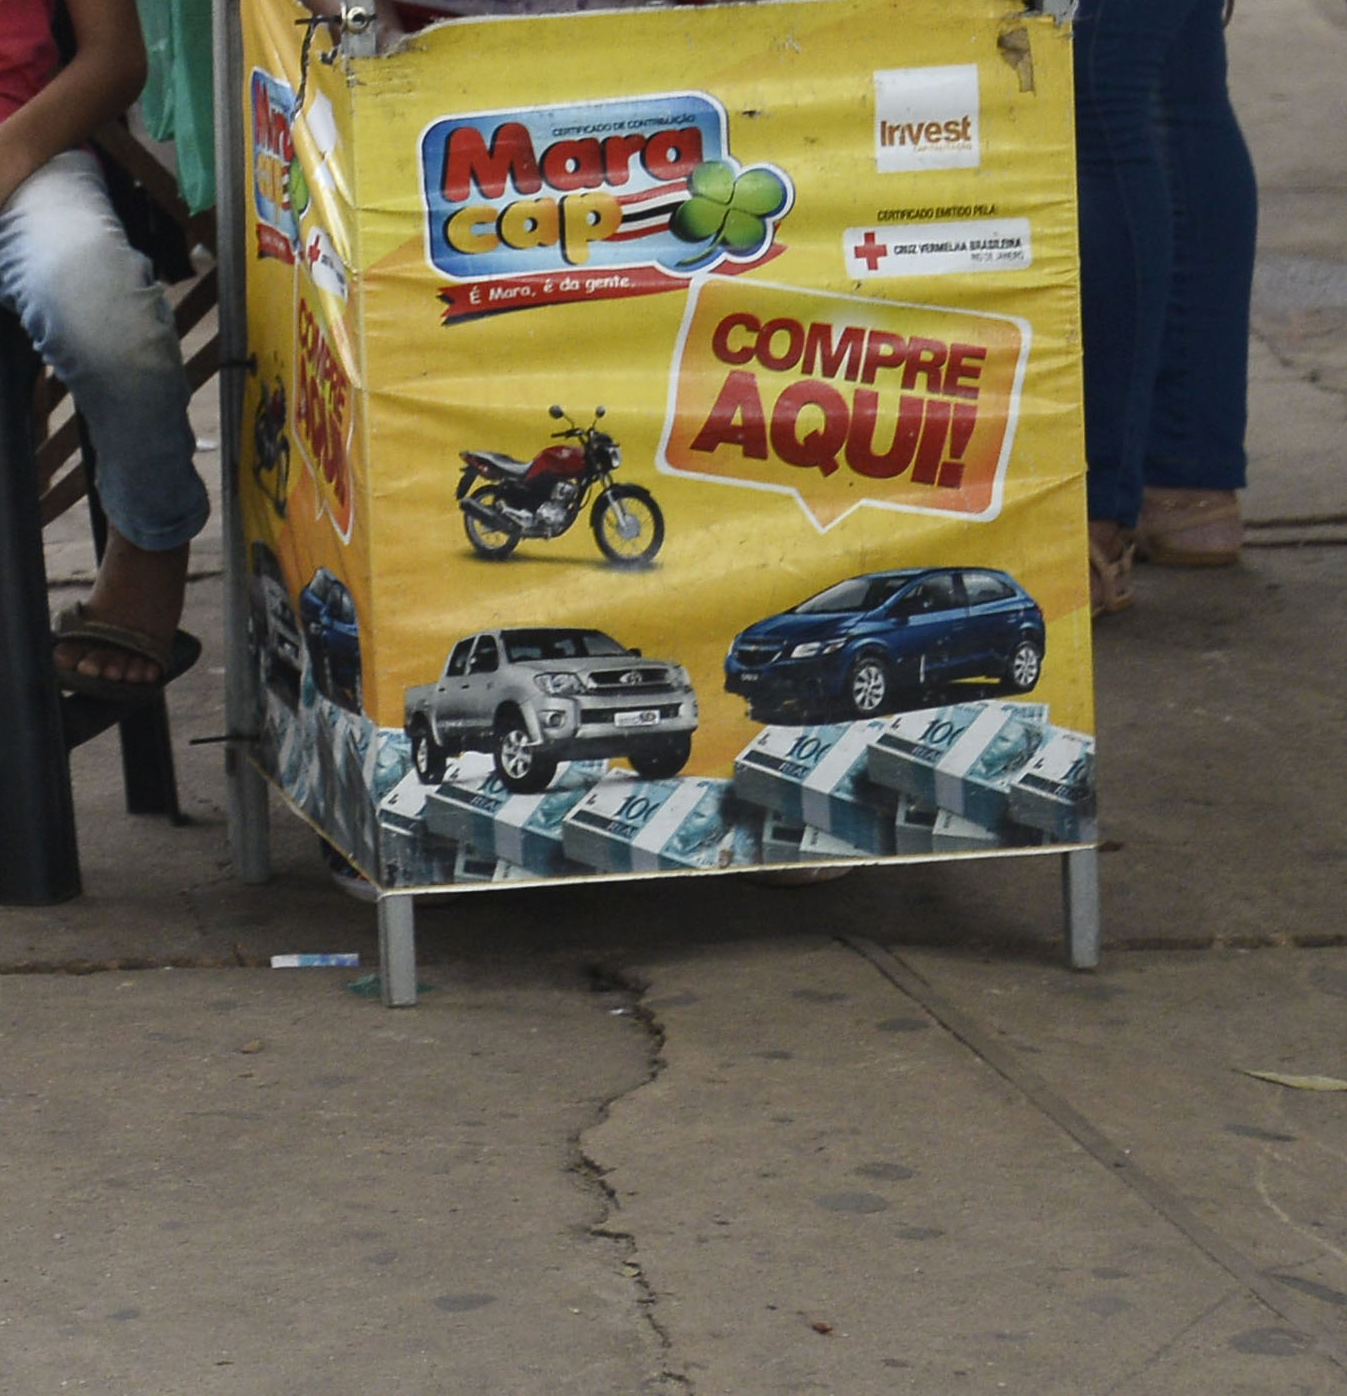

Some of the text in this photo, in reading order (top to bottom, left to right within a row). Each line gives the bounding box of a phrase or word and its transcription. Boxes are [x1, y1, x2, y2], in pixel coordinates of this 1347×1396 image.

[552, 123, 612, 137] CERTIFICADO
[614, 121, 625, 130] DE
[880, 115, 971, 148] Invest
[441, 122, 704, 203] Mara
[445, 191, 623, 266] cap
[877, 207, 933, 222] CERTIFICADO
[469, 285, 480, 305] É
[560, 277, 580, 292] da
[711, 313, 987, 400] COMPRE
[689, 370, 978, 490] AQUI!
